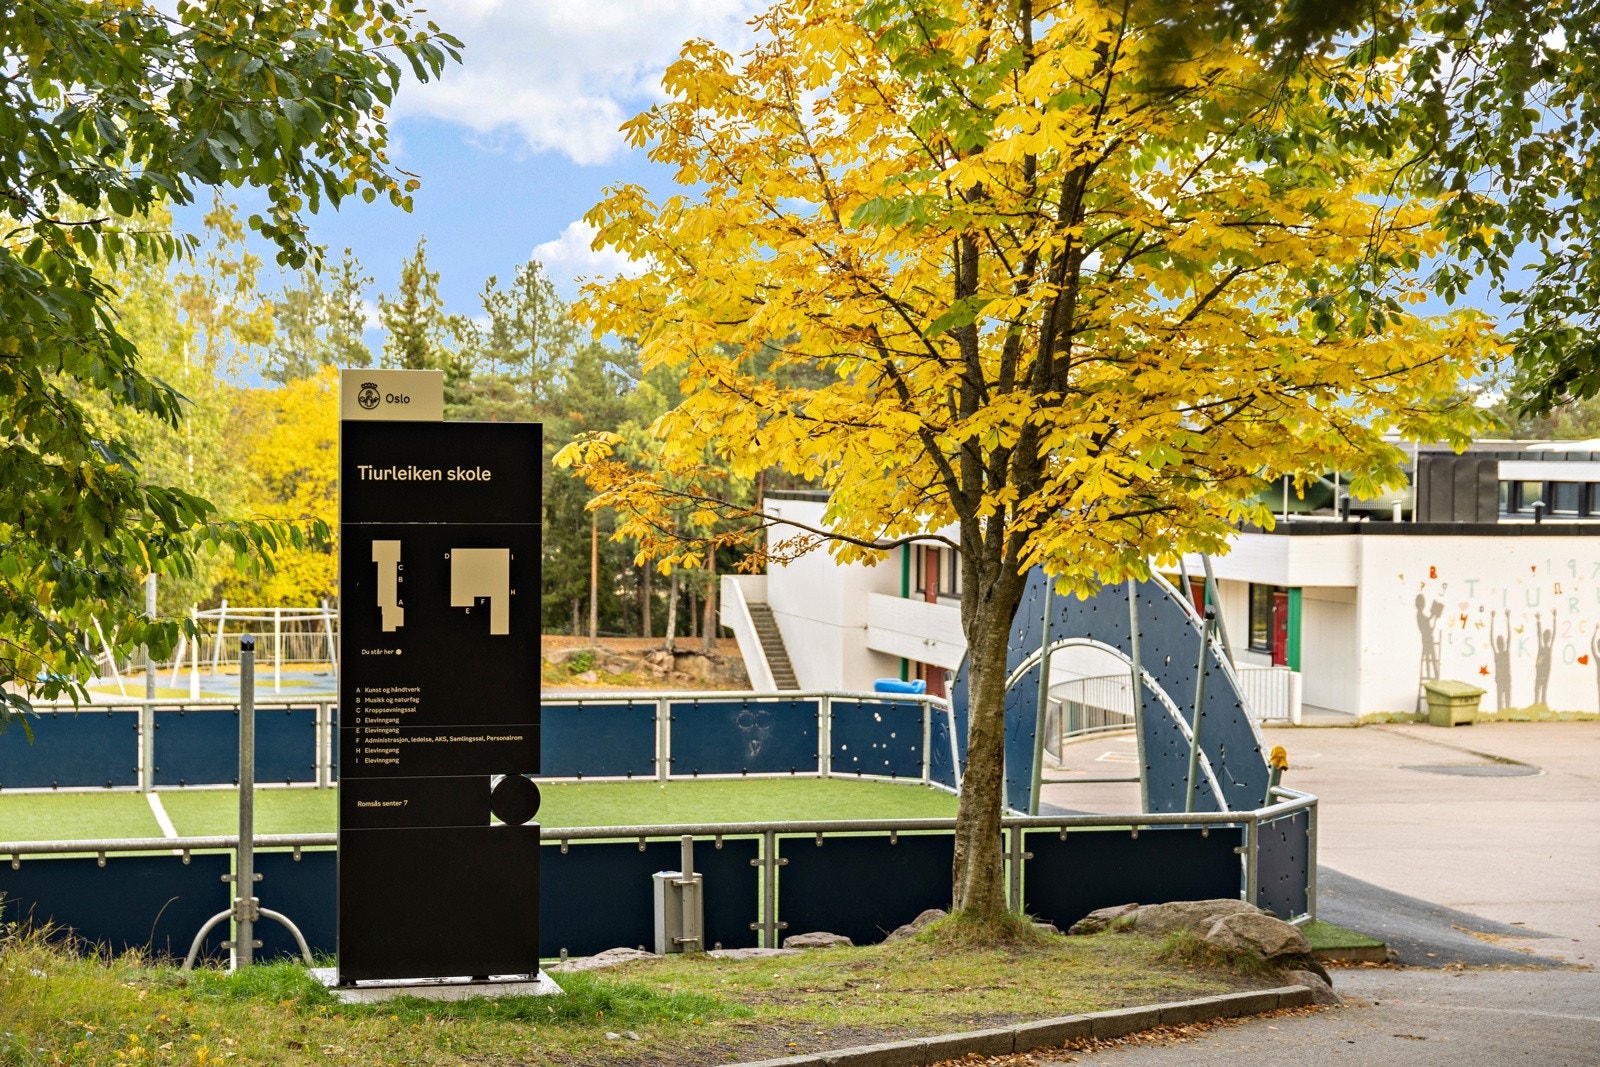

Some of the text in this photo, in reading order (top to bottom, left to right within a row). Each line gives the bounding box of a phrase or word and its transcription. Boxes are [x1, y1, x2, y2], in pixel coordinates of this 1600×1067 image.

[385, 393, 411, 404] Oslo
[357, 465, 492, 481] Tiurleiken skole
[390, 686, 421, 694] håndtverk
[393, 696, 420, 704] naturfag
[449, 735, 486, 743] Samlingssal,
[364, 747, 399, 755] Elevinngang
[364, 757, 399, 765] Elevinngang
[357, 800, 382, 808] Romsås
[403, 799, 409, 807] 7
